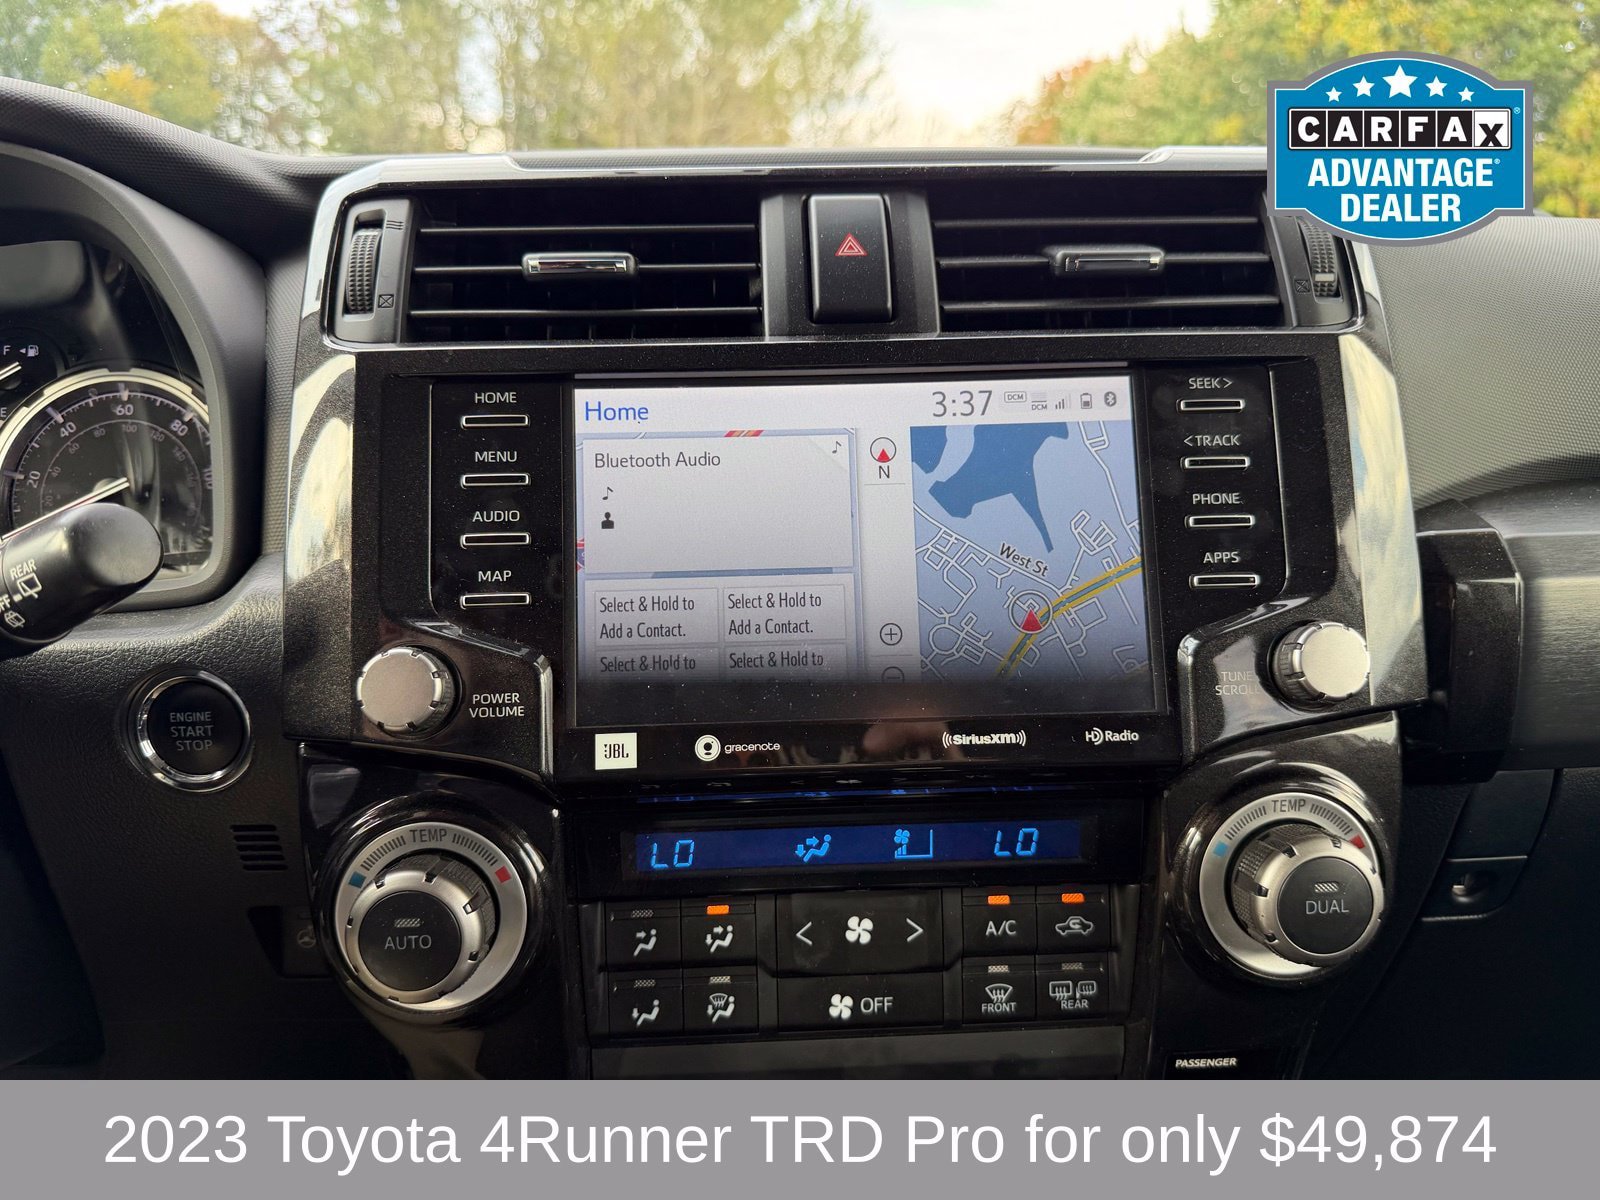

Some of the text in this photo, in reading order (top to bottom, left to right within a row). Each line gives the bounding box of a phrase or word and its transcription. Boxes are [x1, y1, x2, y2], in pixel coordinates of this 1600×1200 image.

[3, 345, 11, 356] F
[474, 391, 517, 404] HOME
[932, 389, 993, 418] 3:37
[115, 404, 134, 416] 60
[584, 400, 649, 422] Home
[1031, 403, 1048, 411] DCM
[59, 421, 77, 438] 40
[170, 419, 188, 437] 80
[68, 442, 80, 455] 60
[474, 450, 518, 463] MENU
[594, 450, 722, 469] Bluetooth Audio
[26, 470, 41, 488] 20
[878, 465, 891, 479] N
[1192, 492, 1241, 505] PHONE
[472, 509, 521, 523] AUDIO
[1000, 542, 1049, 577] West St
[1203, 551, 1241, 564] APPS
[10, 558, 37, 580] REAR
[478, 570, 512, 583] MAP
[599, 595, 695, 613] Select & Hold to
[728, 592, 822, 609] Select & Hold to
[599, 621, 687, 639] Add a Contact.
[728, 618, 814, 635] Add a Contact.
[600, 654, 696, 672] Select & Hold to
[729, 651, 824, 669] Select & Hold to
[1220, 671, 1253, 682] TUNE
[1214, 684, 1261, 696] SCROLL
[472, 692, 520, 705] POWER
[169, 711, 212, 723] ENGINE
[469, 705, 525, 718] VOLUME
[171, 724, 214, 738] START
[1105, 730, 1140, 742] Radio
[175, 739, 214, 752] STOP
[604, 743, 630, 760] JBL
[724, 742, 781, 755] gracenote
[1271, 798, 1307, 813] TEMP
[409, 828, 448, 843] TEMP
[1305, 899, 1350, 915] DUAL
[985, 919, 1017, 937] A/C
[384, 934, 432, 951] AUTO
[859, 996, 894, 1014] OFF
[981, 1001, 1017, 1014] FRONT
[1060, 999, 1090, 1010] REAR
[1175, 1057, 1238, 1069] PASSENGER
